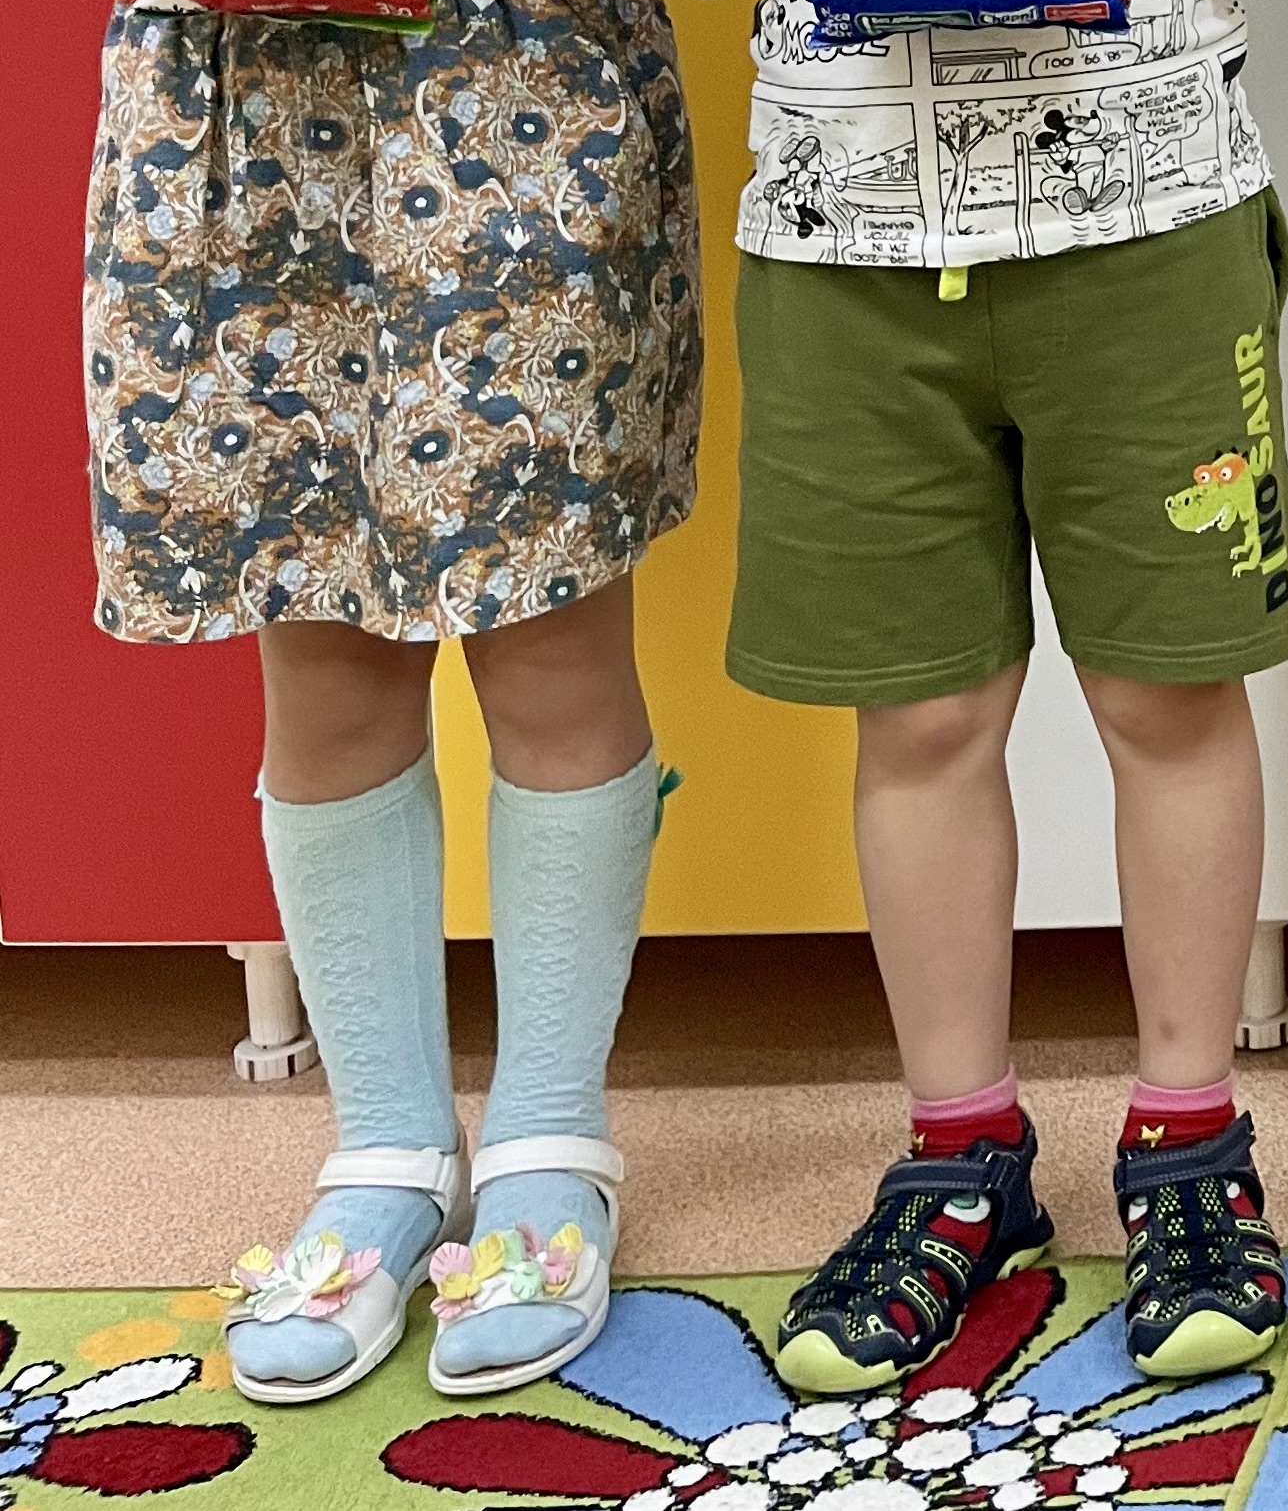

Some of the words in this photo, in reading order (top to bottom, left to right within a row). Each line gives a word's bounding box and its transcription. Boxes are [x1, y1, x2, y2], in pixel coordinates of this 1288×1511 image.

[1164, 72, 1200, 90] THESE
[1134, 91, 1178, 110] WEEKS
[1181, 85, 1196, 98] OF
[1147, 95, 1202, 118] TRAINING
[1147, 116, 1179, 128] WILL
